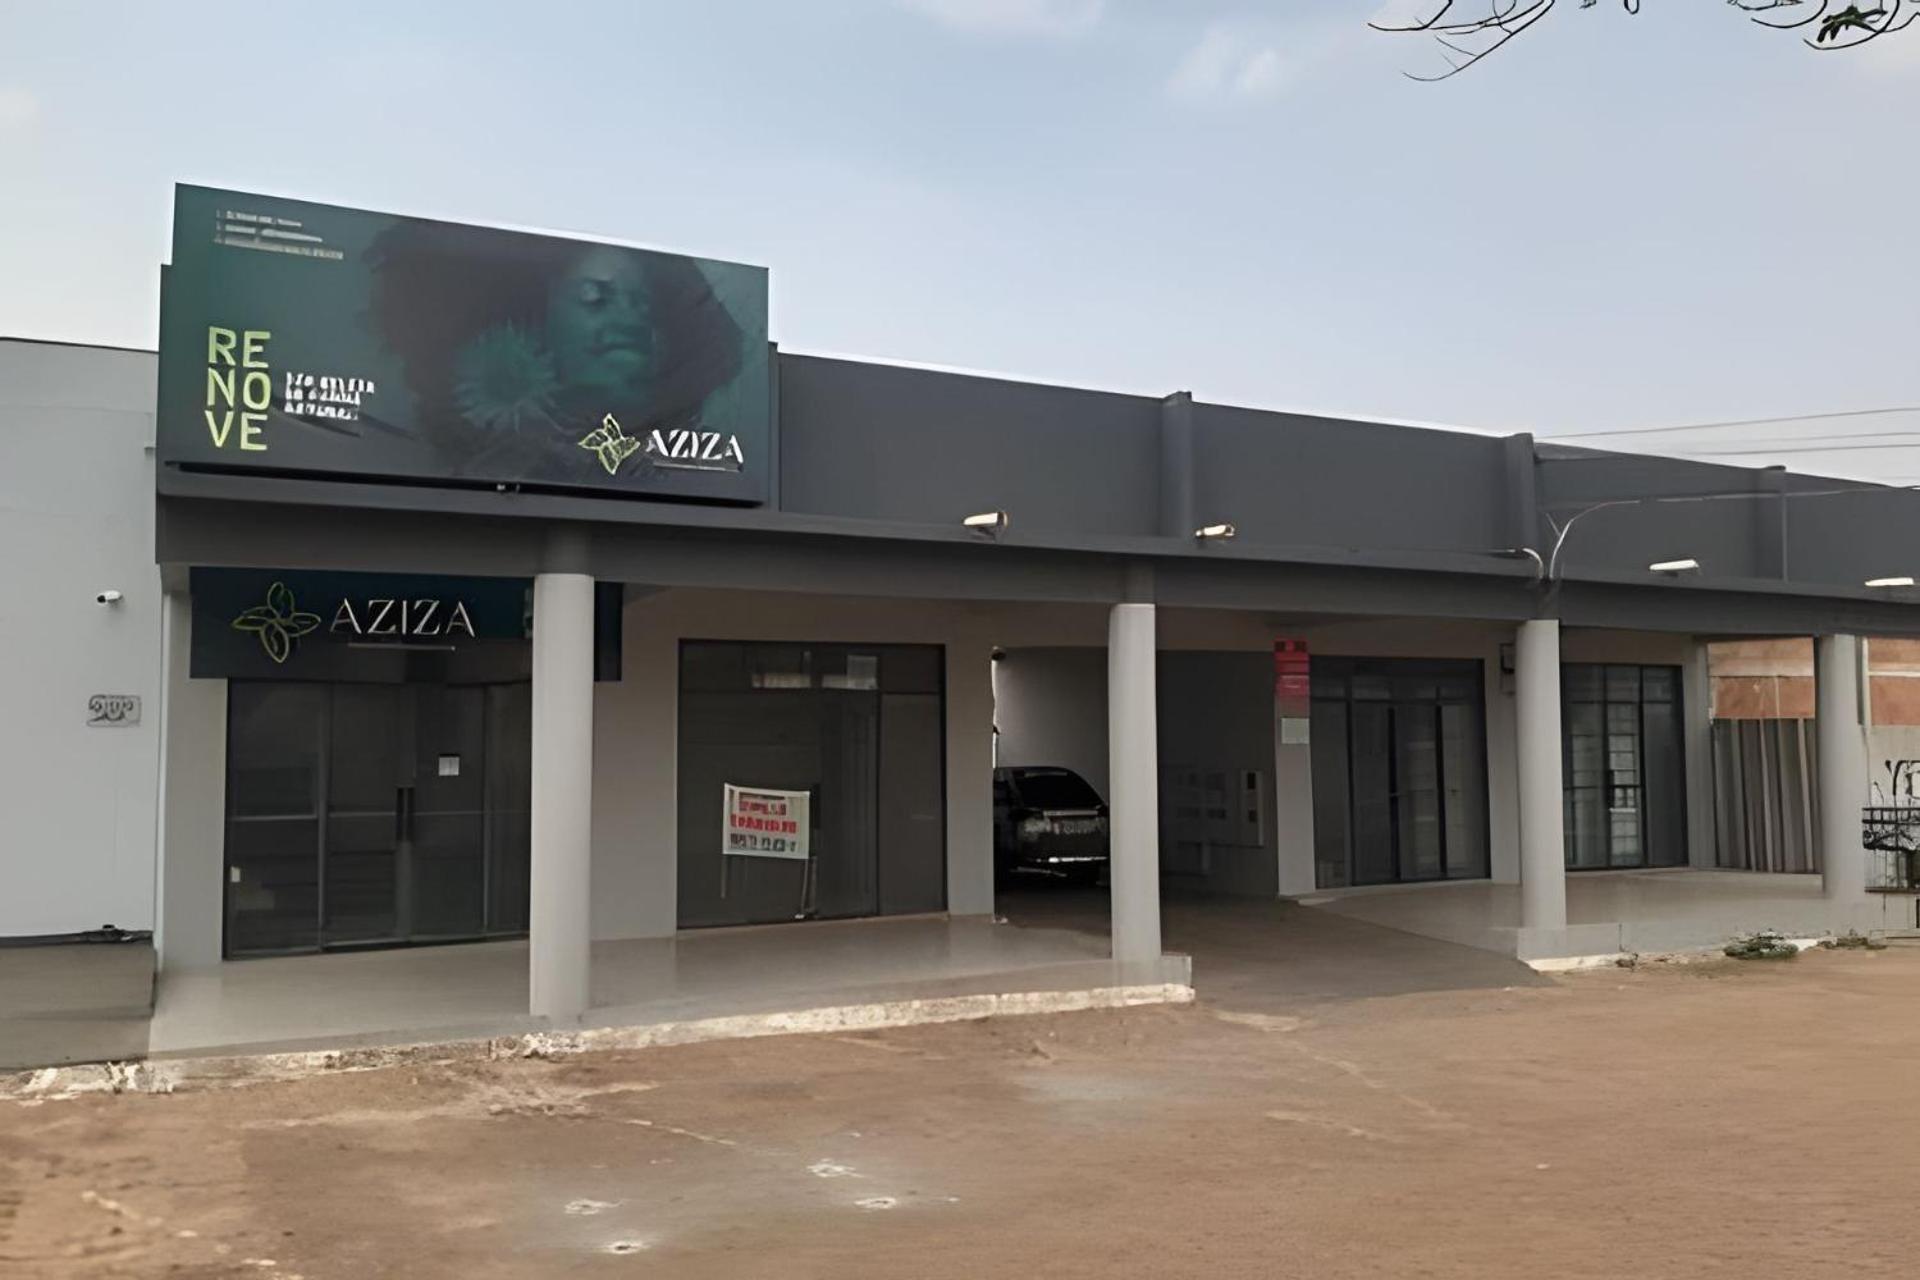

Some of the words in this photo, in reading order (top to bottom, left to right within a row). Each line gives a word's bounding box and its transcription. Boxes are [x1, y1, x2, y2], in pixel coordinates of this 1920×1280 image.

[208, 326, 271, 368] RE
[207, 367, 271, 411] NO
[205, 410, 268, 450] VE
[646, 429, 744, 464] AZIZA
[330, 597, 476, 638] AZIZA
